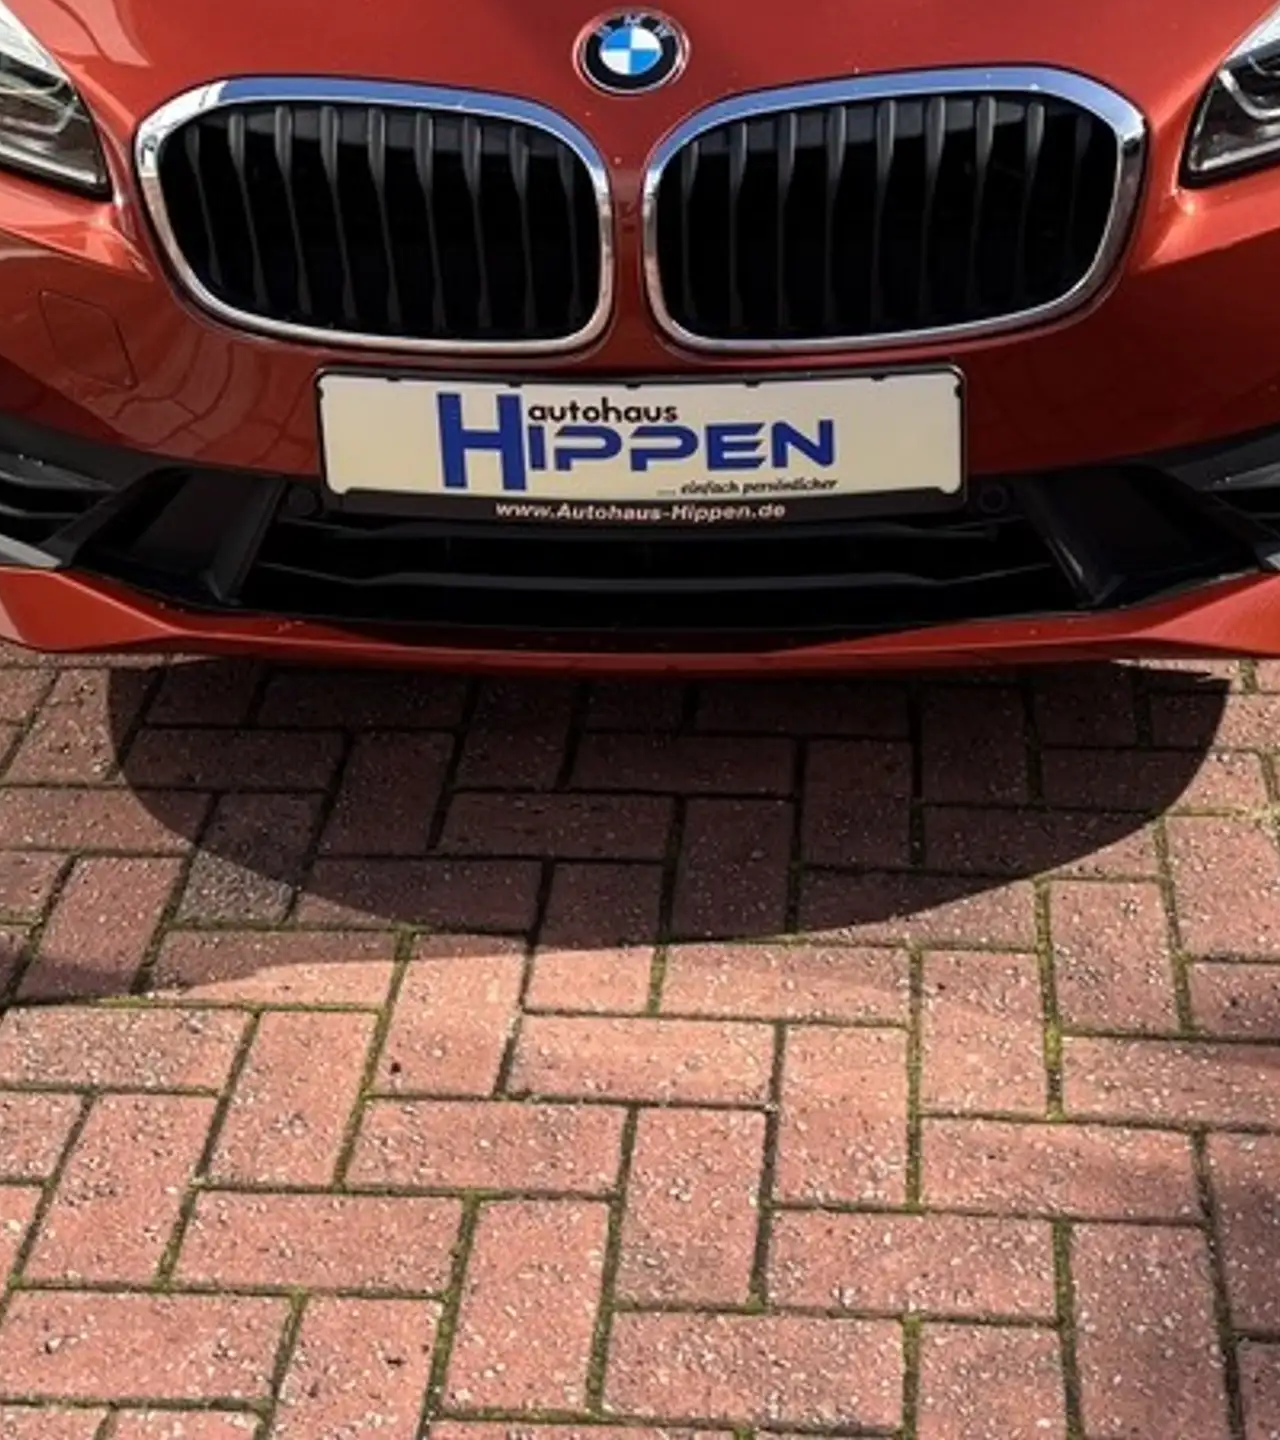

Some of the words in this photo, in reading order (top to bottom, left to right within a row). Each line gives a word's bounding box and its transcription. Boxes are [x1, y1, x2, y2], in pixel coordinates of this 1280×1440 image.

[594, 12, 677, 38] BMW
[528, 397, 678, 424] autohaus
[437, 392, 835, 491] HIPPEN
[495, 501, 786, 524] www.Autohaus-Hippen.de
